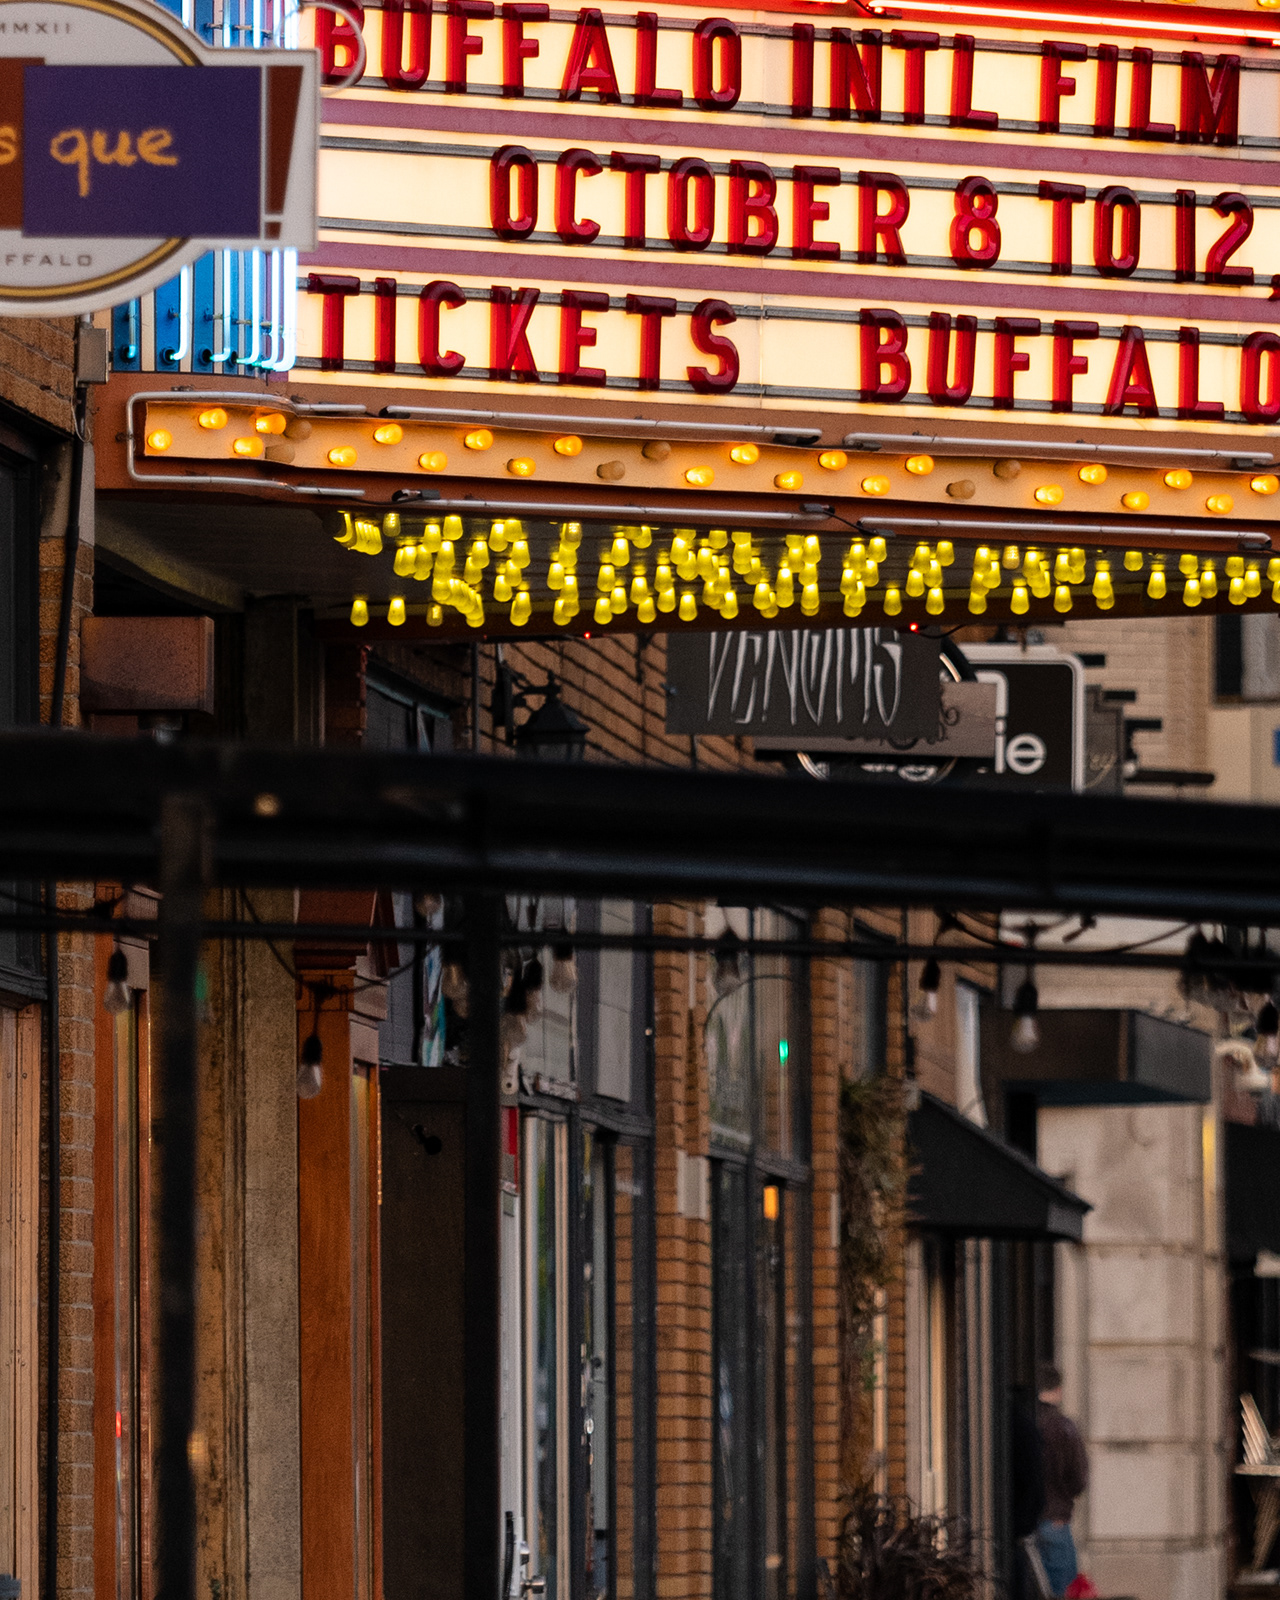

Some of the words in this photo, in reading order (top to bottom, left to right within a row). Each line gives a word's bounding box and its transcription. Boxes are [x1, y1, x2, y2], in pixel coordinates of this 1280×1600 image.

[790, 20, 999, 130] INTL
[1039, 39, 1241, 147] FILM
[49, 125, 180, 198] que
[489, 145, 911, 266] OCTOBER
[951, 174, 1001, 271] 8
[1038, 179, 1141, 279] TO
[308, 273, 740, 395] TICKETS
